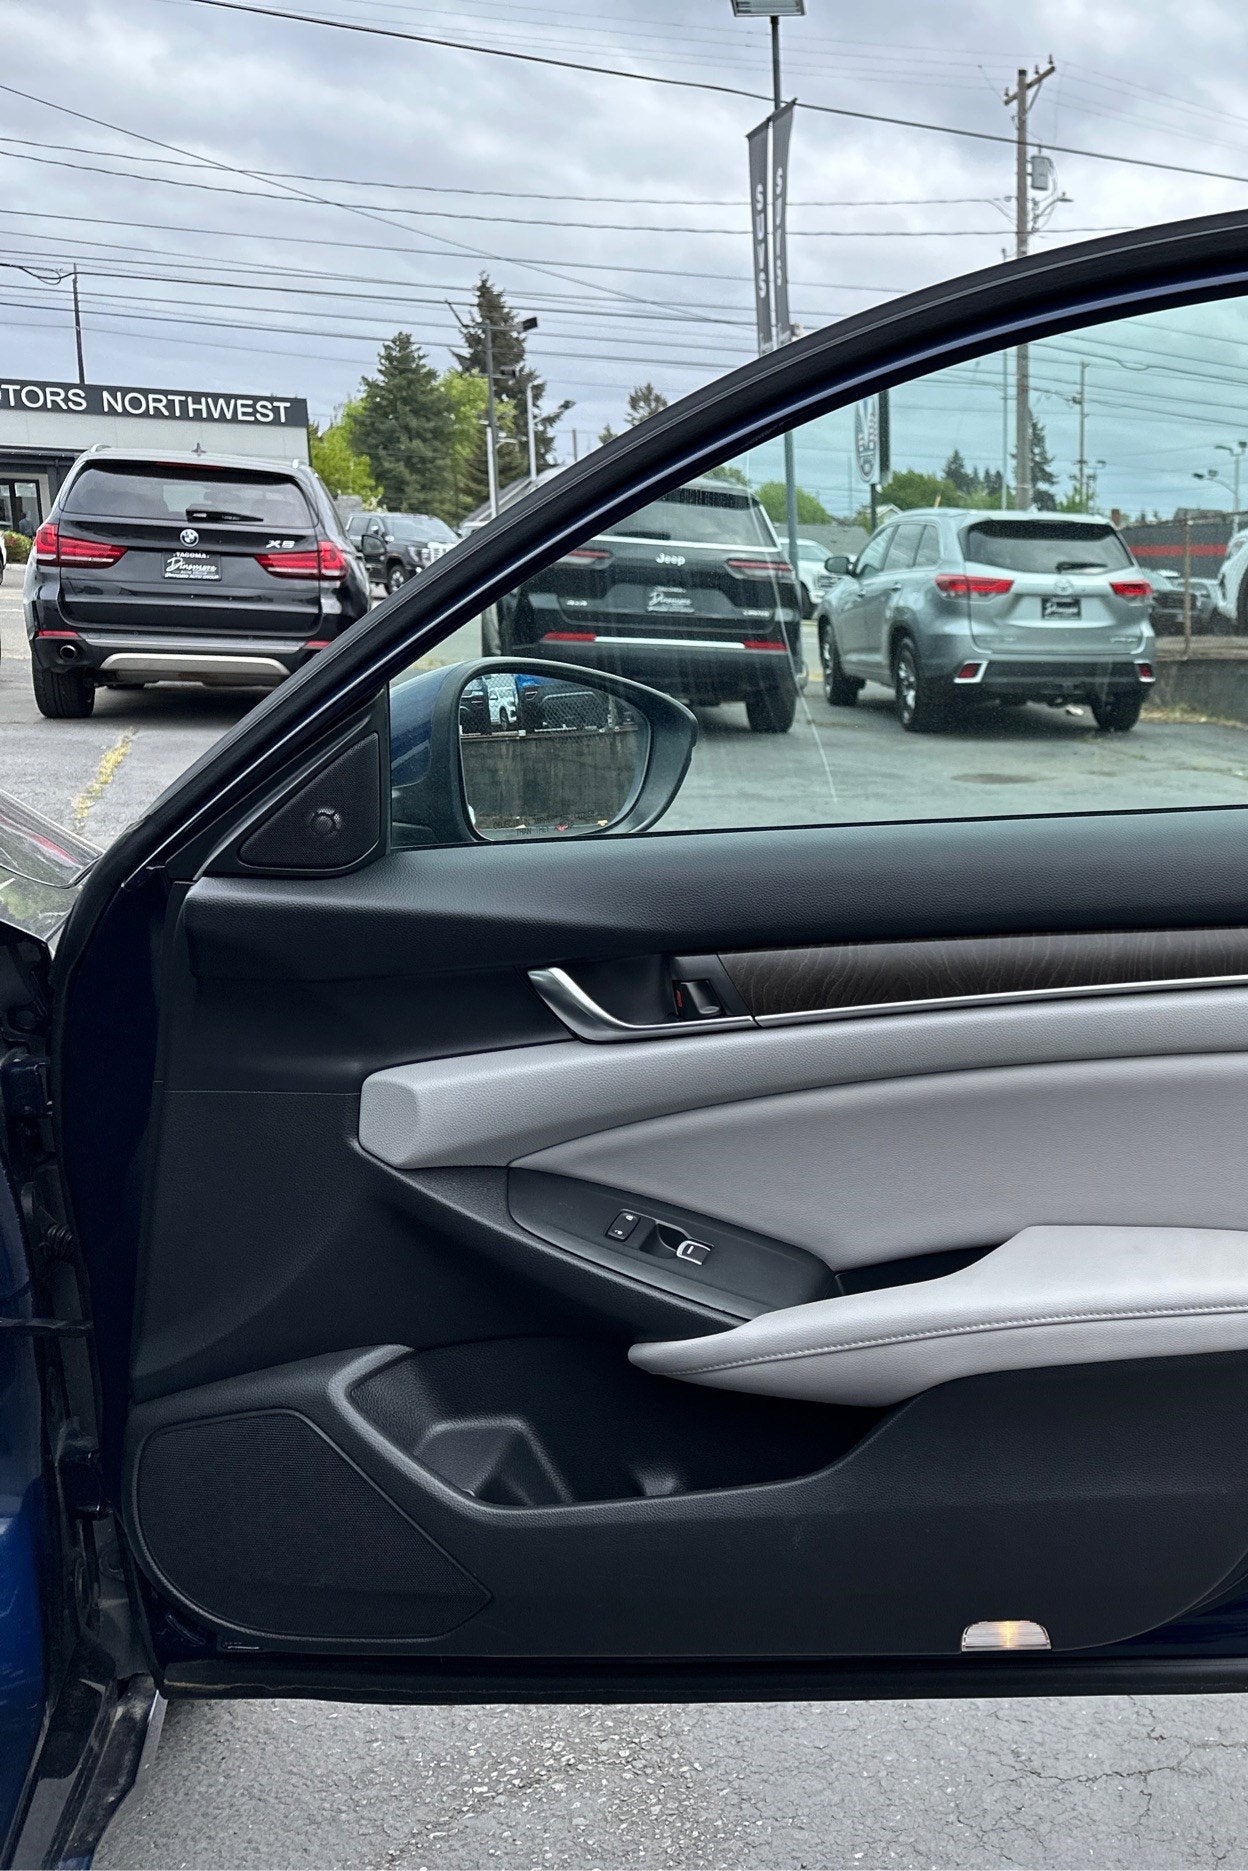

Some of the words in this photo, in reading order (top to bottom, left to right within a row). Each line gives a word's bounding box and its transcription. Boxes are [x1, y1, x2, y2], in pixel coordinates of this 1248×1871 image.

[0, 384, 88, 411] TORS
[102, 391, 291, 423] NORTHWEST
[656, 552, 686, 567] Jeep
